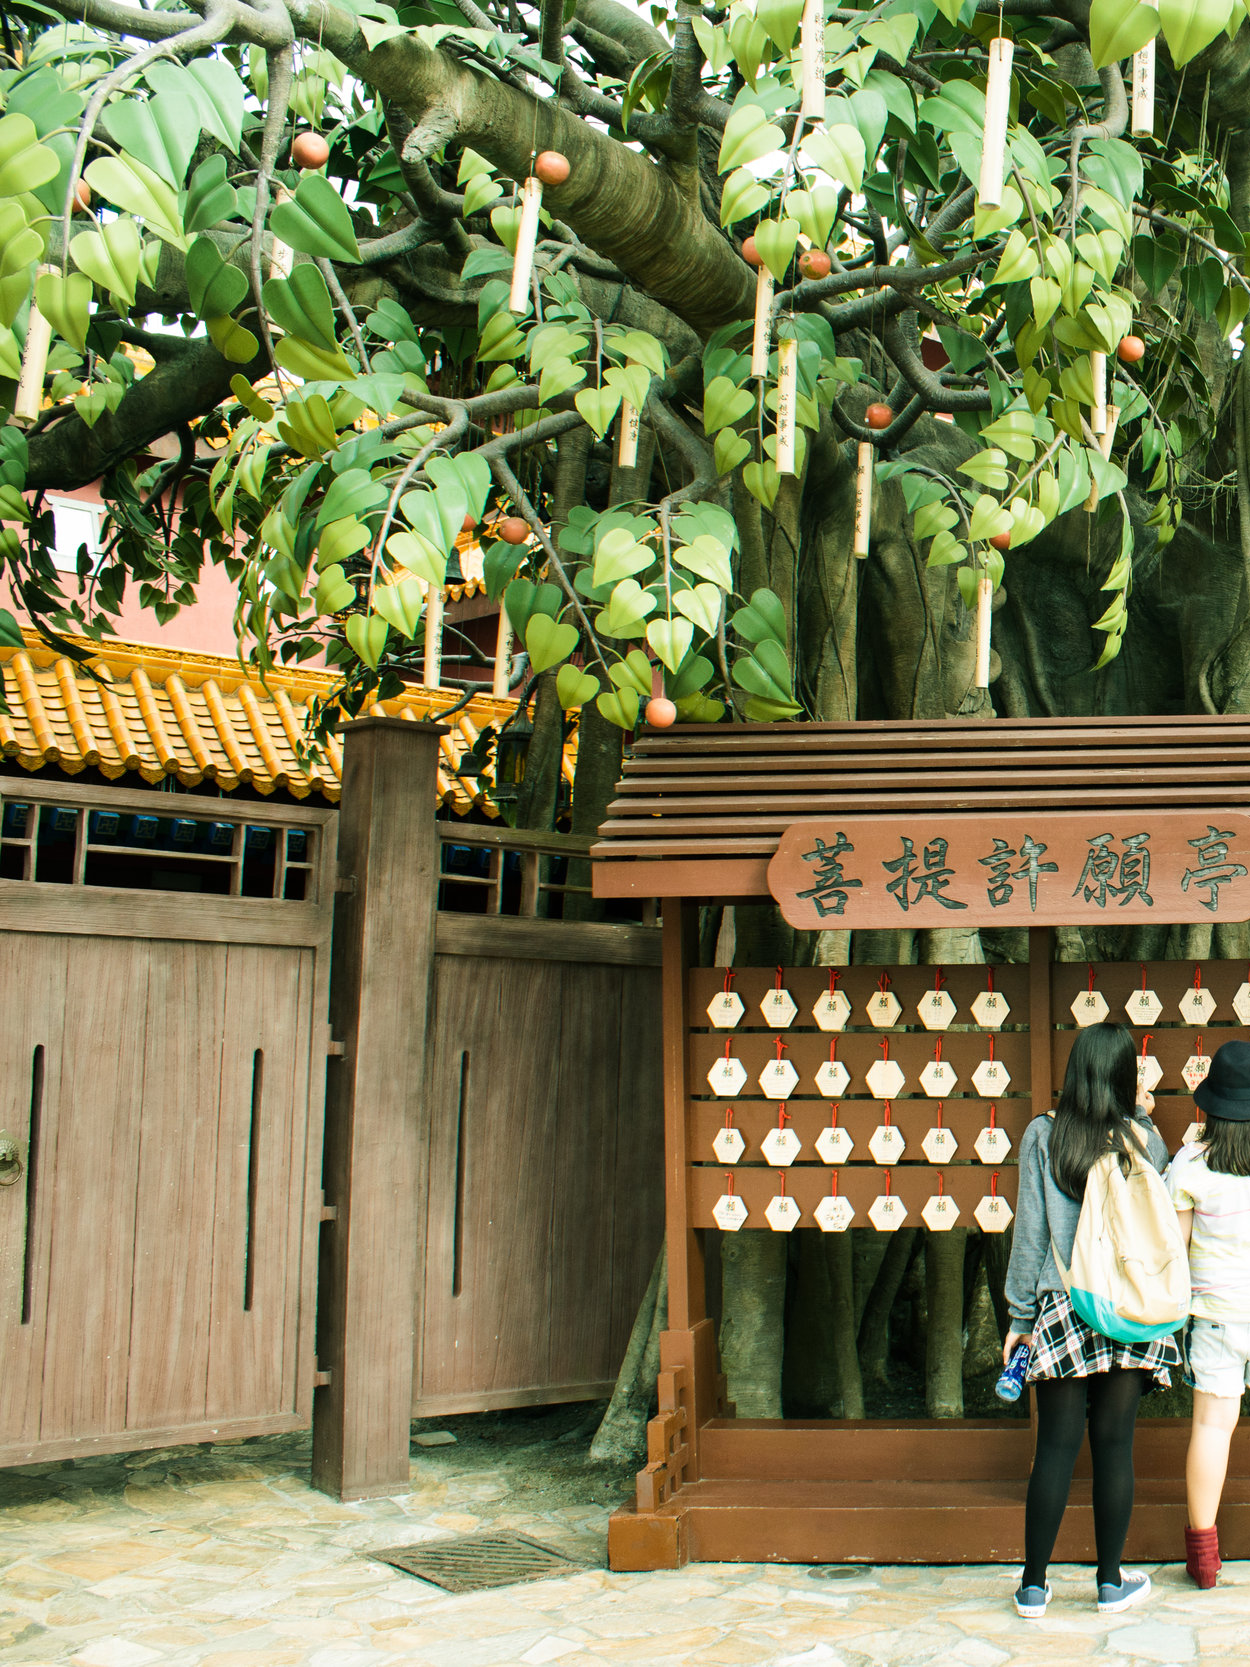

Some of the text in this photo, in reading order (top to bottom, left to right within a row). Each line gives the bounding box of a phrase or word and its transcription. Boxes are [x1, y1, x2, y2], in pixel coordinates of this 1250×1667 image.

[795, 825, 1249, 919] 菩提許願亭
